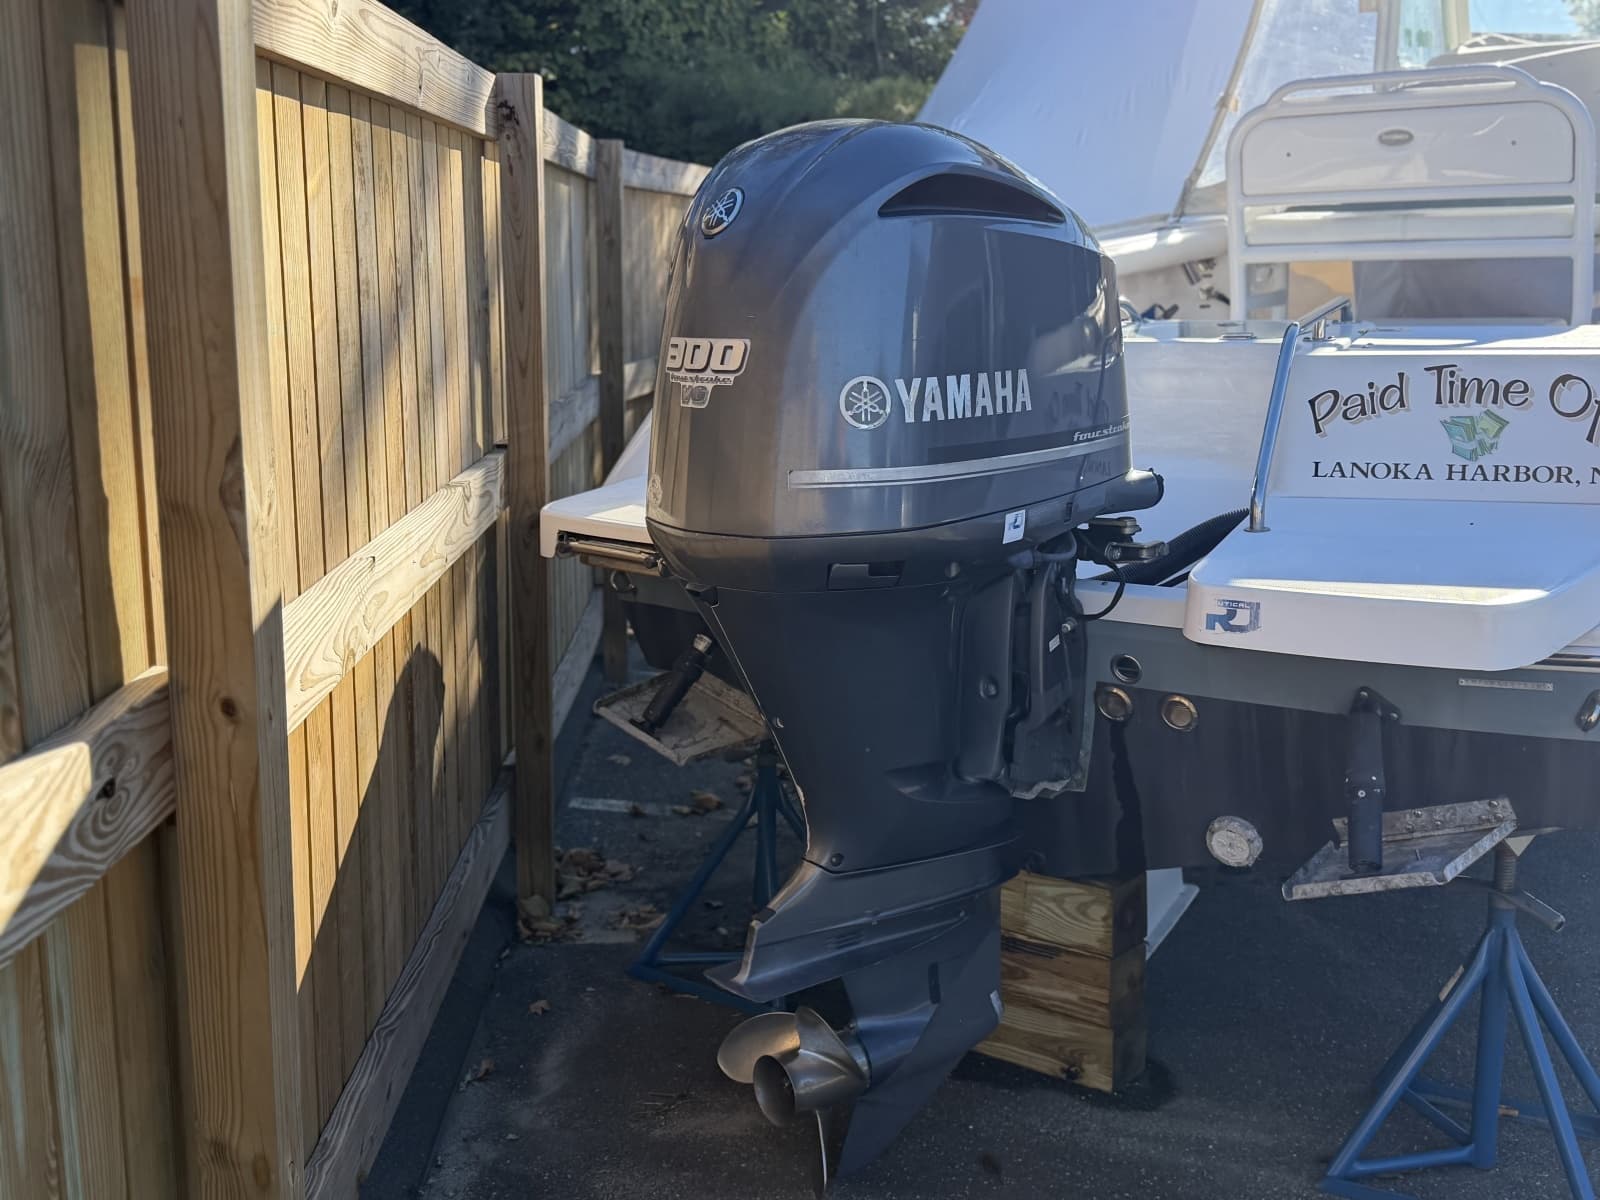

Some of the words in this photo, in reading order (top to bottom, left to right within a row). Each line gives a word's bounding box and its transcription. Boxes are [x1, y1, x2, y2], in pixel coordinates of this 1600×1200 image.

[895, 368, 1032, 423] YAMAHA
[1308, 372, 1408, 435] Paid
[1424, 364, 1531, 408] Time
[1073, 421, 1130, 441] fourstrok
[1312, 461, 1434, 481] LANOKA
[1446, 464, 1581, 487] HARBOR,
